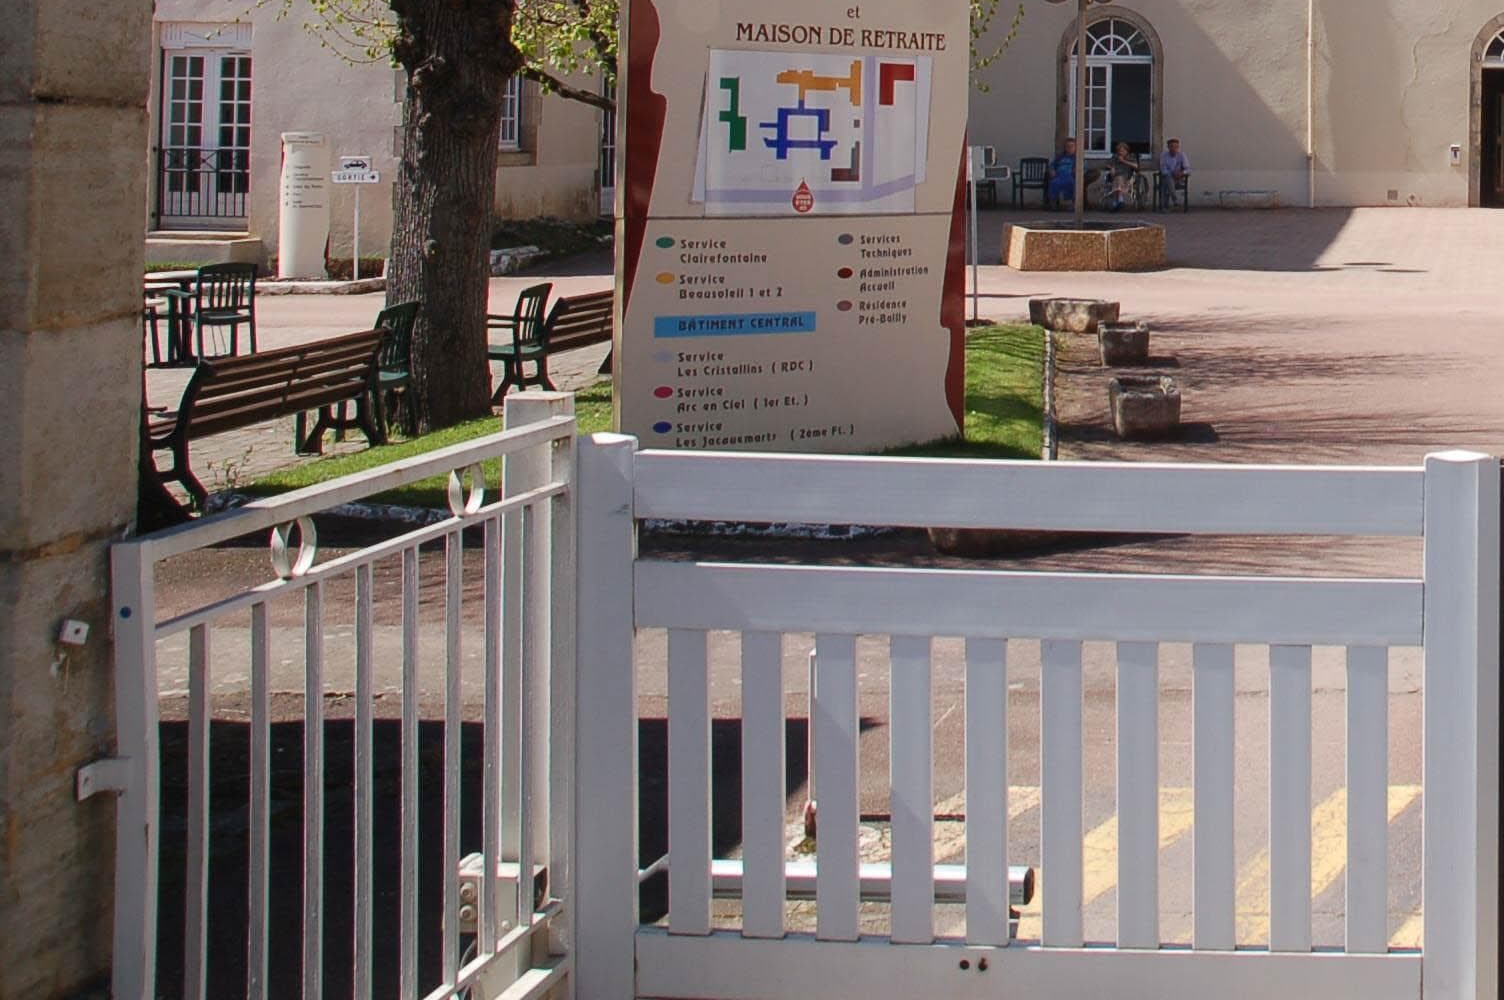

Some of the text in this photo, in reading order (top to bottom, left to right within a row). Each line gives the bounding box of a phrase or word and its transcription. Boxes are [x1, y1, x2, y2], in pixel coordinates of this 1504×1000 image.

[847, 5, 860, 19] et
[736, 23, 946, 51] MAISON DE RETRAITE
[680, 239, 727, 249] Service
[860, 235, 900, 245] Services
[680, 253, 768, 264] Clairefontaine
[861, 248, 912, 259] Techniques
[860, 266, 929, 279] Administration
[679, 274, 726, 285] Service
[860, 281, 895, 293] Accueil
[679, 288, 744, 299] Beausoleil
[759, 288, 771, 298] et
[776, 287, 783, 297] 2
[750, 316, 804, 329] CENTRAL
[678, 352, 724, 363] Service
[678, 367, 698, 377] Les
[703, 363, 763, 375] Cristallins
[677, 387, 724, 398] Service
[677, 402, 697, 413] Arc
[703, 402, 717, 411] en
[723, 399, 745, 410] Ciel
[676, 421, 723, 432] Service
[676, 437, 697, 447] Les
